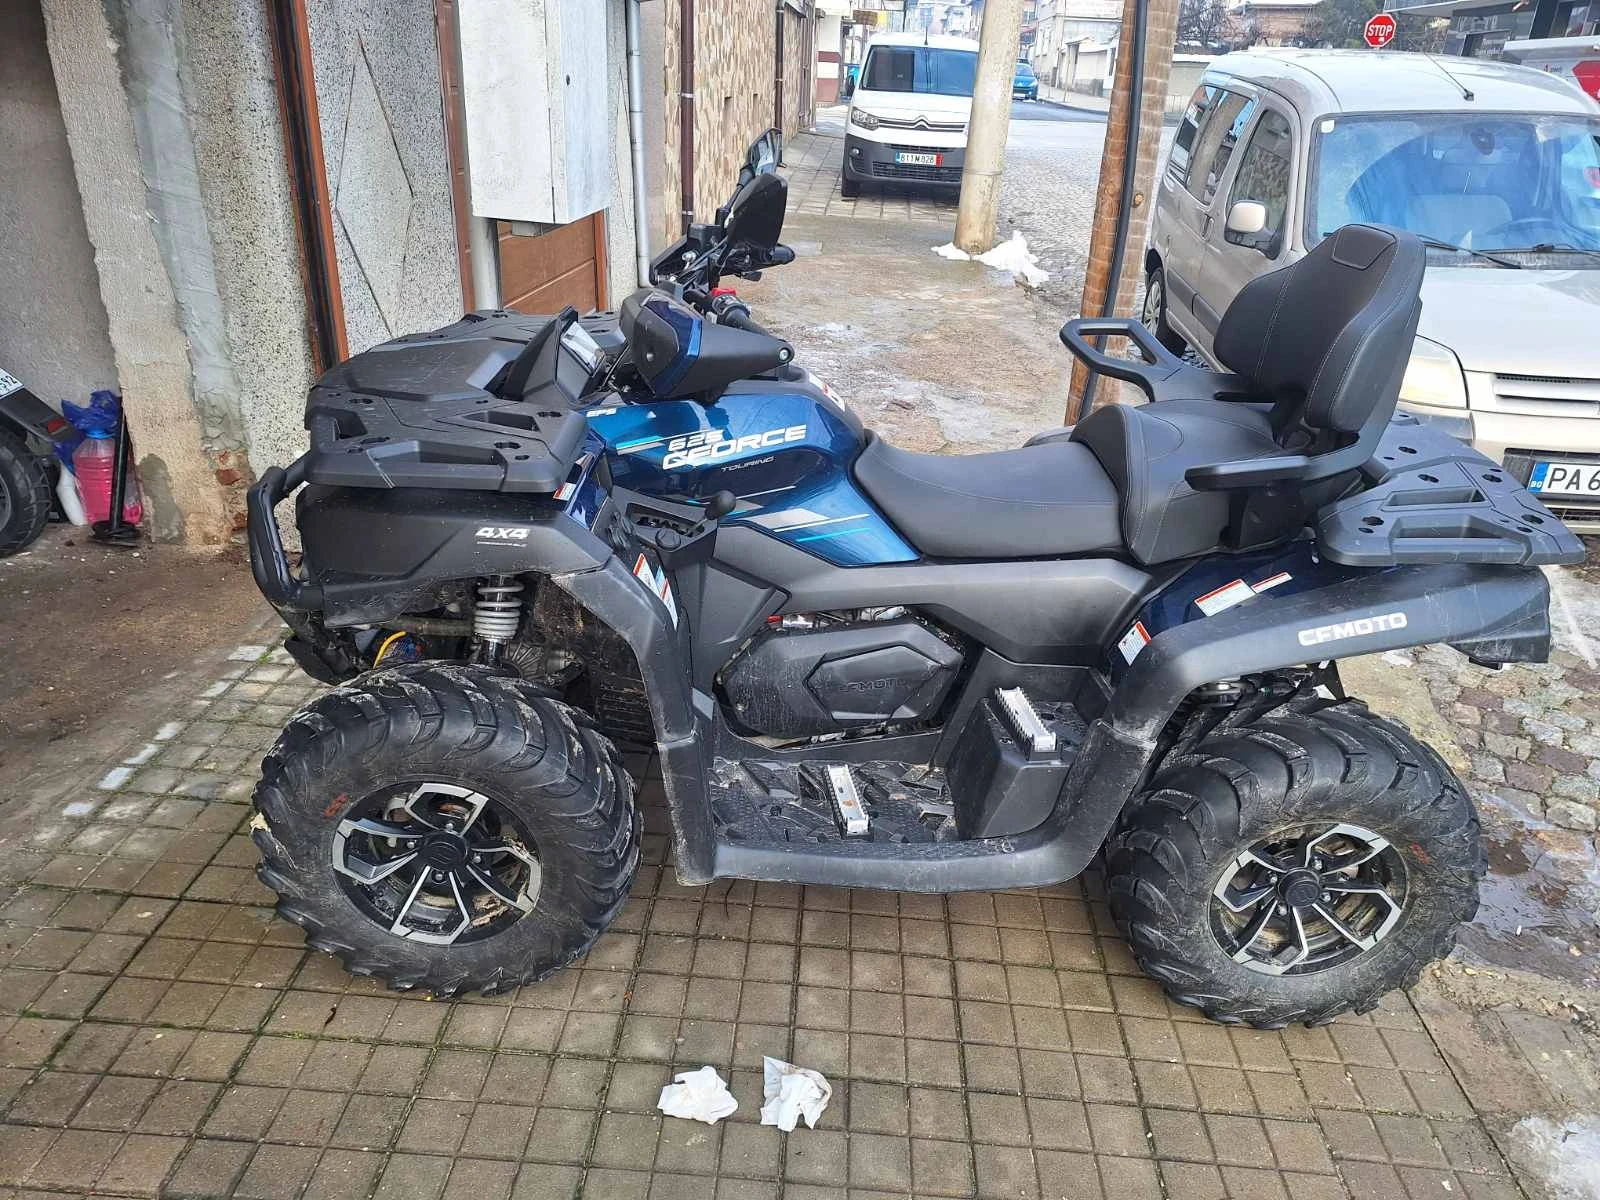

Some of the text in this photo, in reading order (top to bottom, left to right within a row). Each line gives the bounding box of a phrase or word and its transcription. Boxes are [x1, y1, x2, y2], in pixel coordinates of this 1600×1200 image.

[1367, 24, 1393, 37] STOP
[668, 429, 724, 452] 625
[720, 455, 775, 473] TOURING
[1298, 612, 1408, 647] CFMOTO
